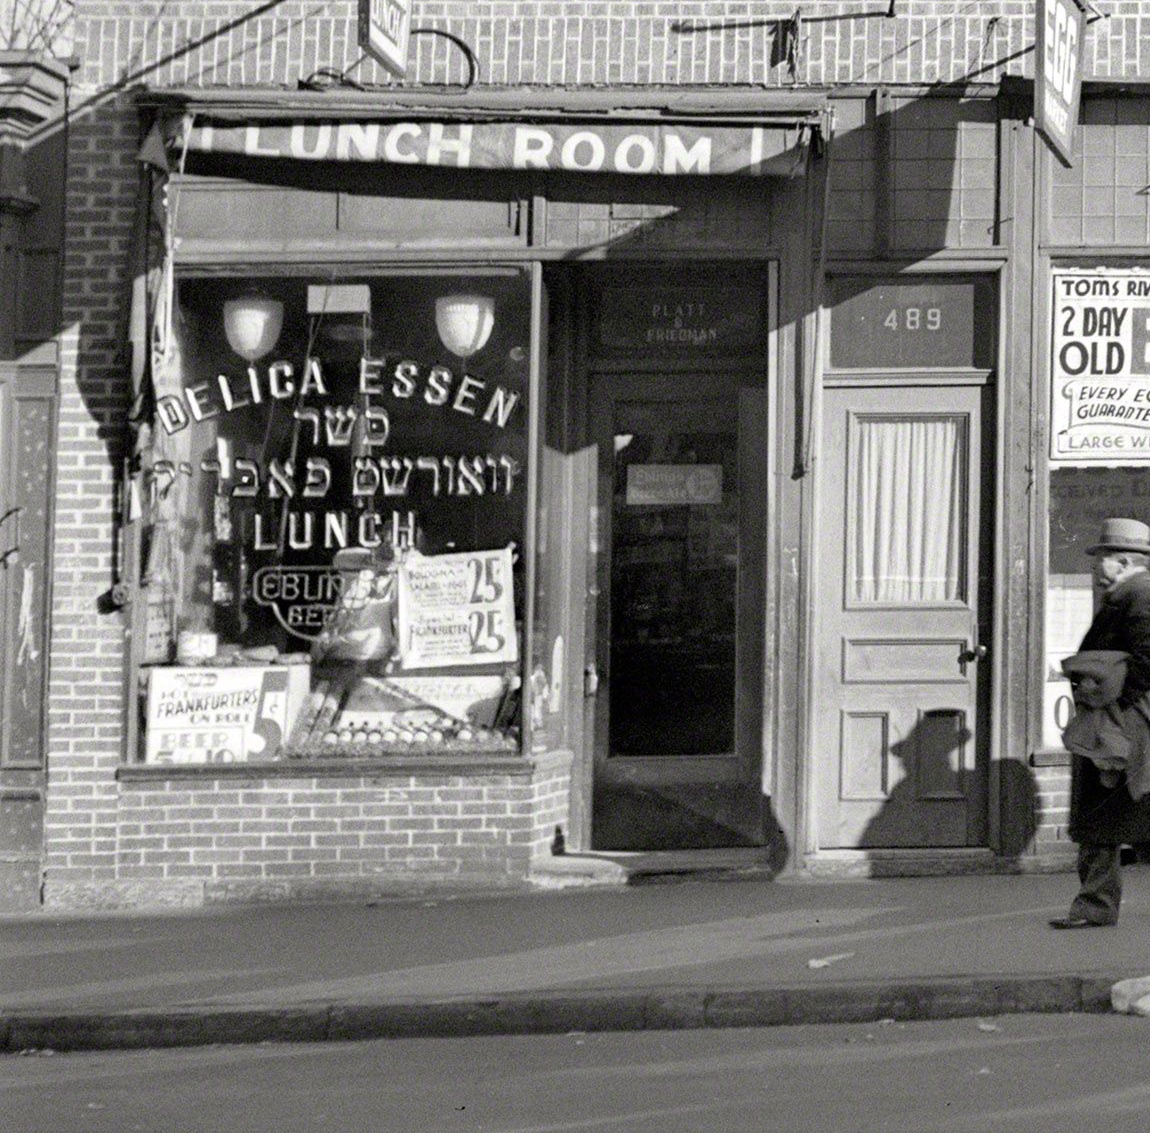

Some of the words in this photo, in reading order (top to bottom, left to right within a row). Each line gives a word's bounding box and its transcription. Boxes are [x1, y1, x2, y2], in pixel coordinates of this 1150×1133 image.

[244, 123, 472, 169] LUNCH
[513, 128, 711, 175] ROOM
[652, 303, 705, 317] PLATT
[884, 308, 941, 330] 489
[1062, 306, 1076, 337] 2
[1083, 307, 1128, 337] DAY
[646, 328, 717, 343] FRIEDMAN
[1059, 341, 1125, 376] OLD
[359, 356, 520, 428] ESSEN
[1079, 386, 1128, 401] EVERY
[1069, 435, 1125, 449] LARGE
[254, 510, 416, 550] LUNCH
[261, 571, 347, 601] EBLIN
[157, 688, 259, 719] FRANKFURTERS
[160, 732, 229, 750] BEER
